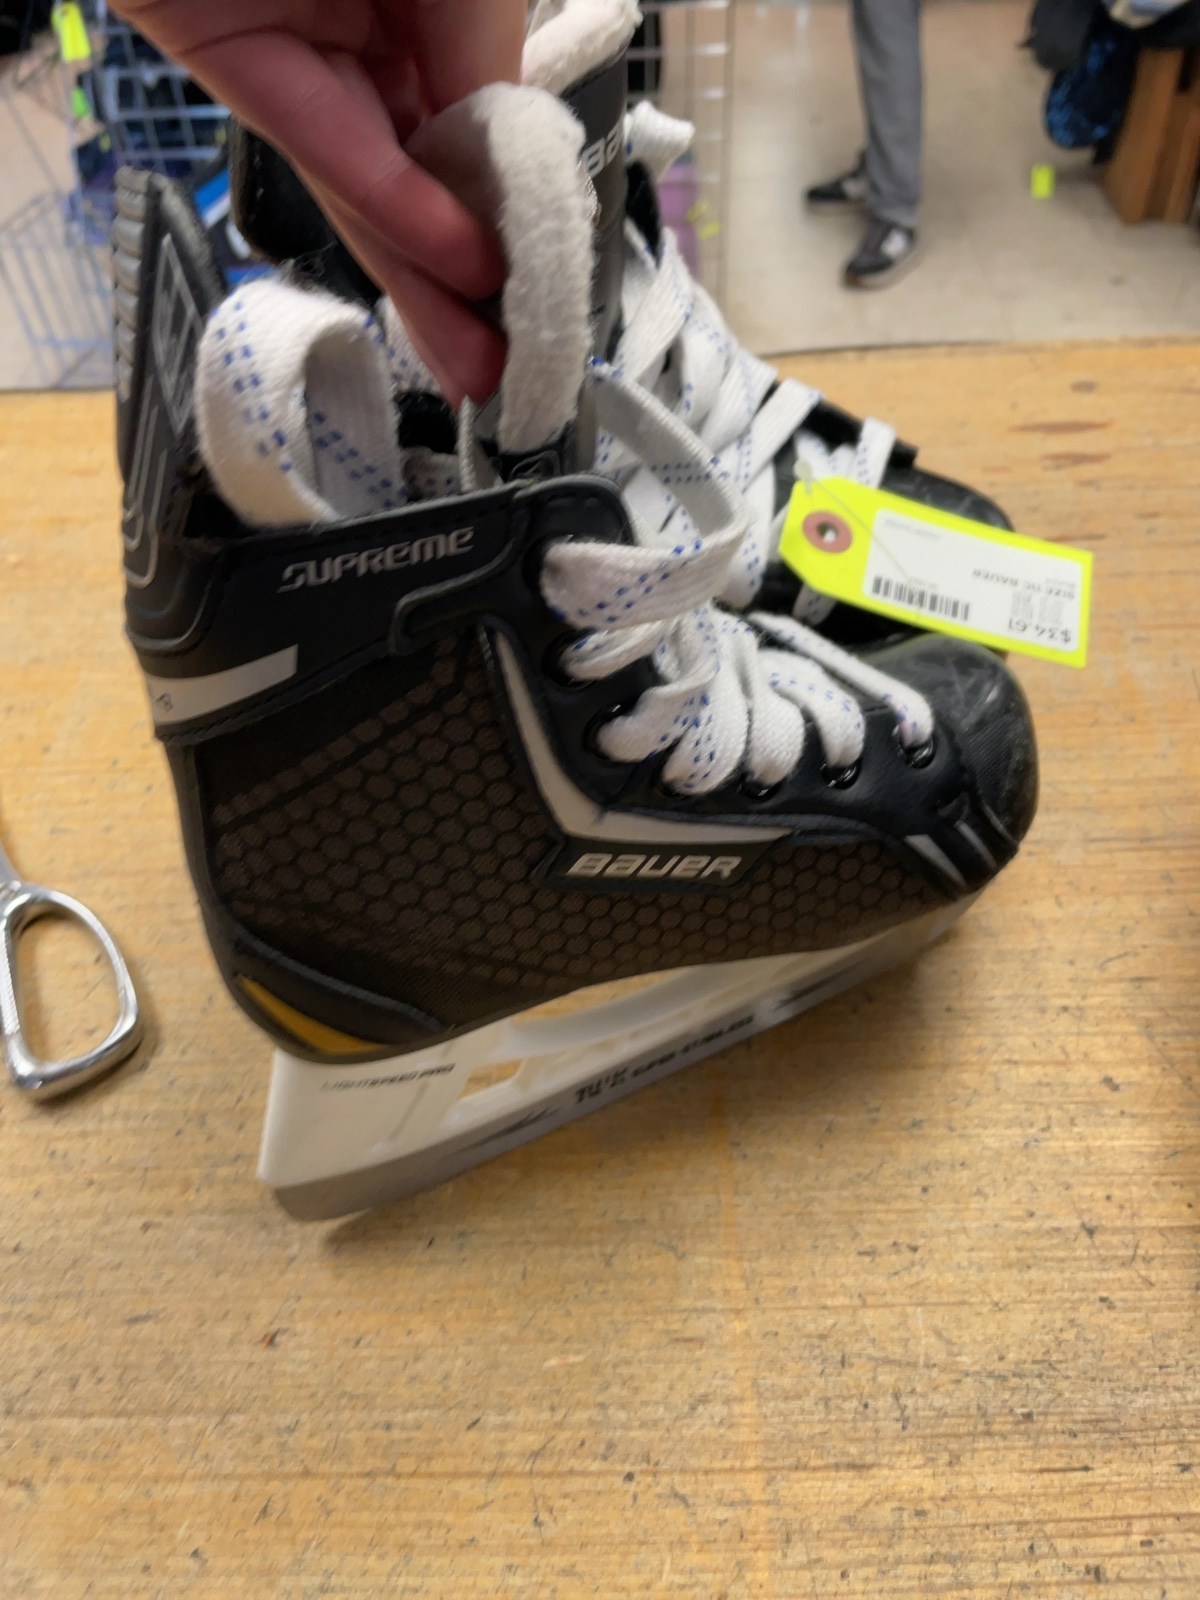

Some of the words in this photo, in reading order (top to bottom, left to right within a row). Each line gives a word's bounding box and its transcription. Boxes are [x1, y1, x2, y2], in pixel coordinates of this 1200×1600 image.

[276, 525, 475, 594] SUPREME
[971, 567, 1019, 587] BAUER
[1045, 585, 1075, 601] SIZE
[1007, 617, 1072, 643] $34.61
[565, 852, 742, 880] BAUER
